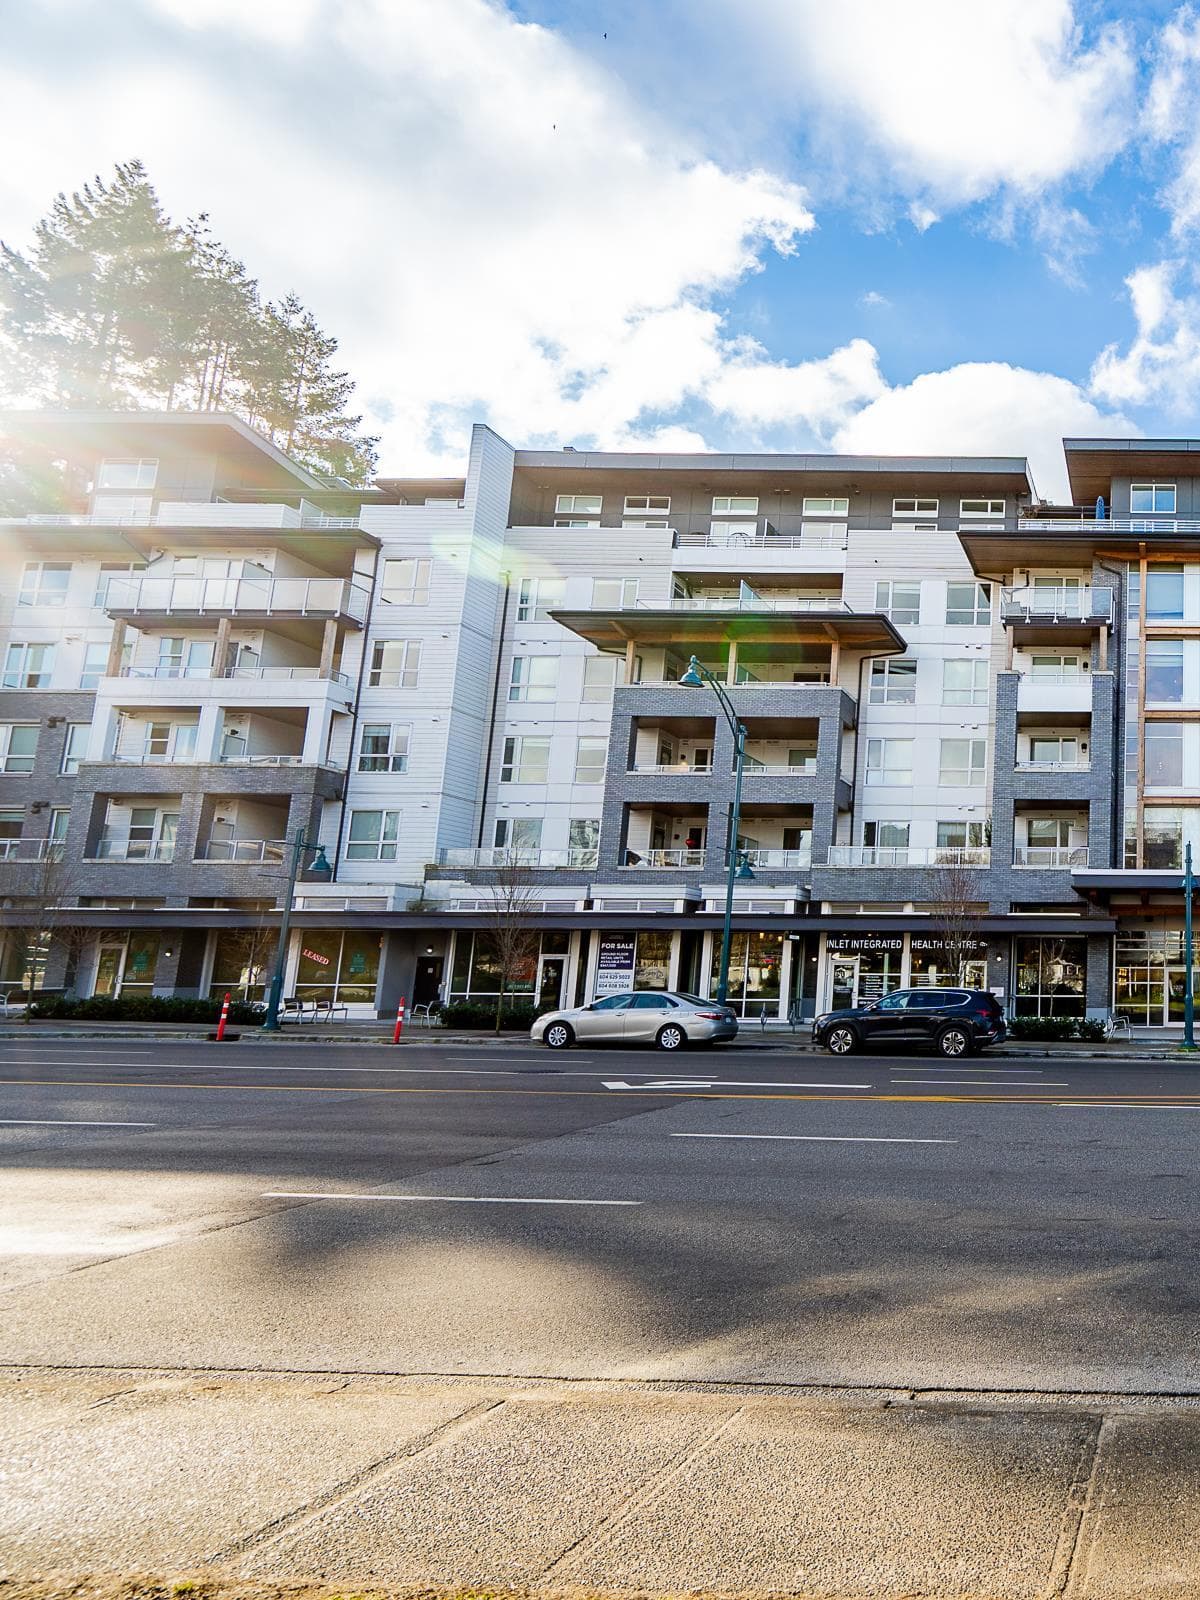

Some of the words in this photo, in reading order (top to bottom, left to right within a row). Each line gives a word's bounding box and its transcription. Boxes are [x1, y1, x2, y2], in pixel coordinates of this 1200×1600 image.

[826, 939, 850, 949] INLET
[851, 939, 902, 949] INTEGRATED
[911, 939, 943, 949] HEALTH
[303, 949, 330, 965] LEASED
